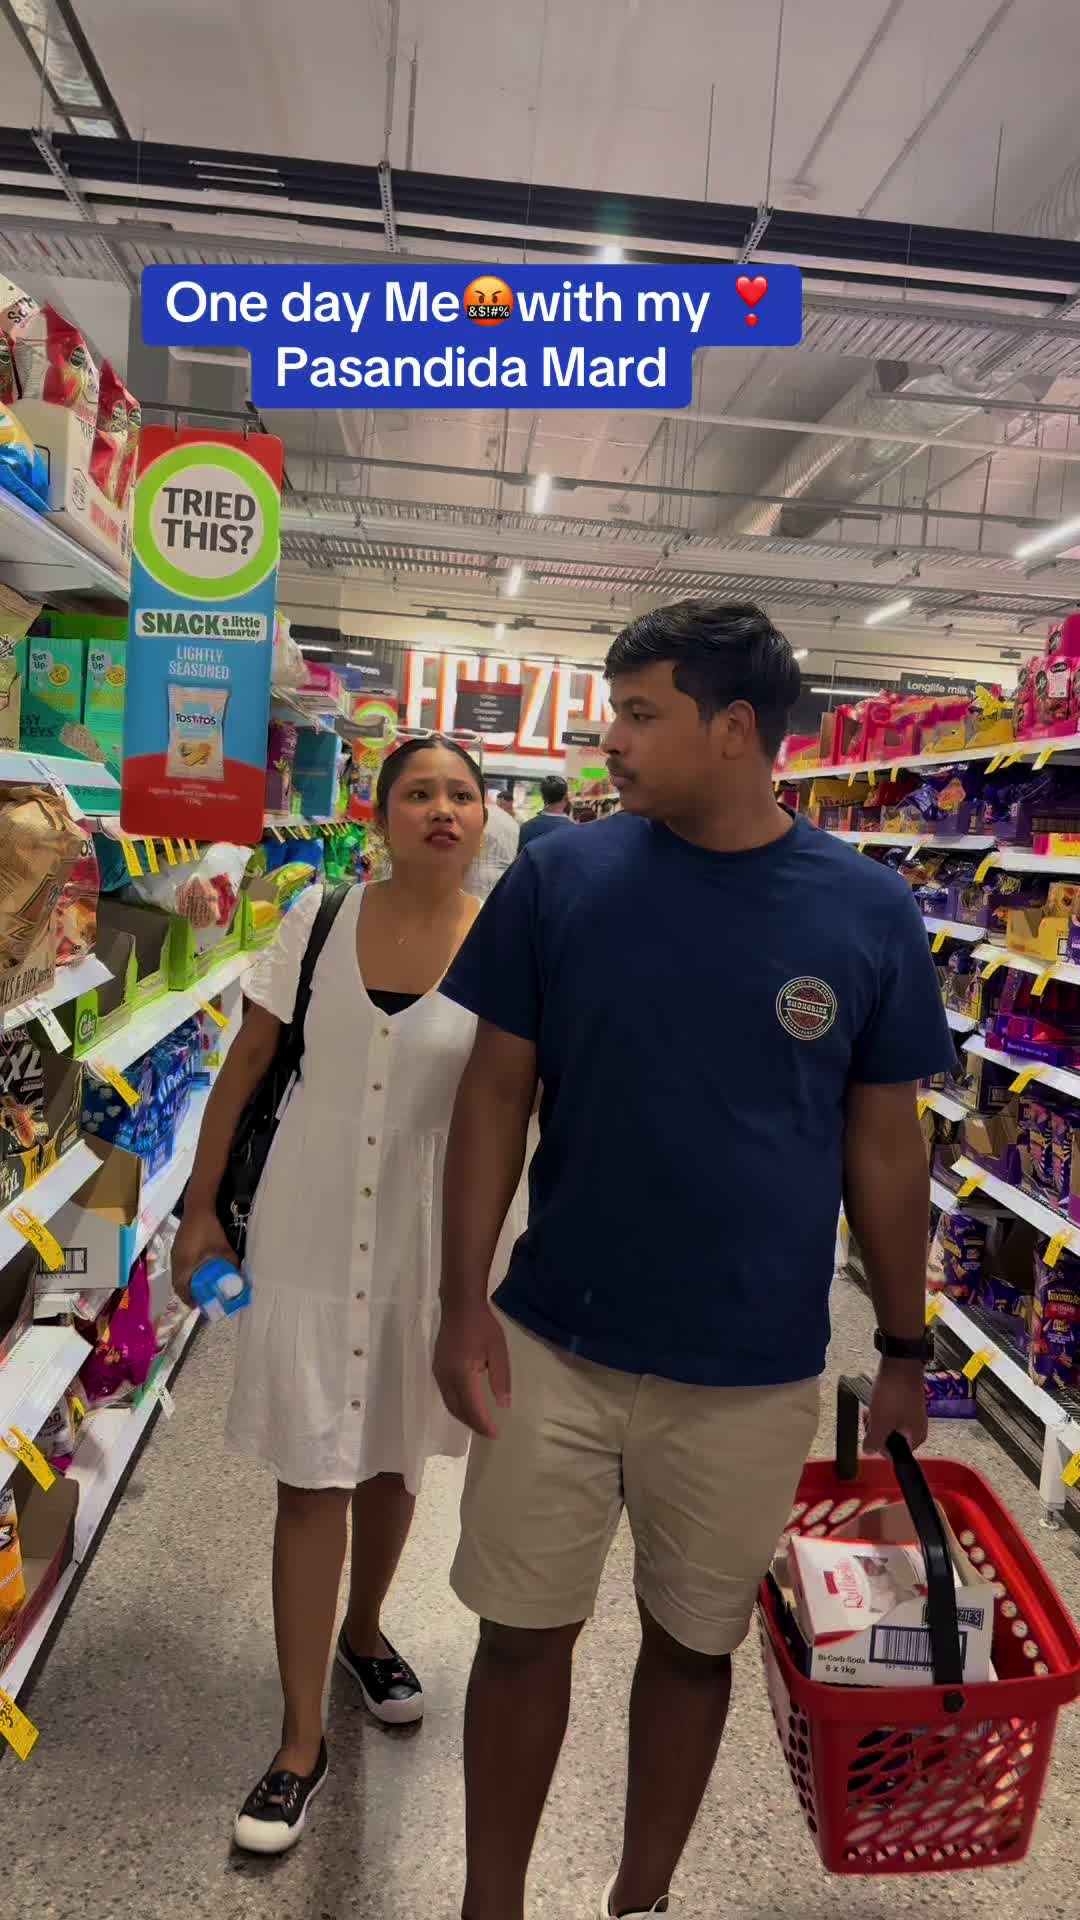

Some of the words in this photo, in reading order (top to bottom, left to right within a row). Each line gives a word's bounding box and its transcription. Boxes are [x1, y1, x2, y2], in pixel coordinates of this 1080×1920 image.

[162, 487, 256, 522] TRIED
[161, 518, 254, 555] THIS?
[142, 612, 220, 636] SNACK
[222, 618, 230, 627] a
[232, 615, 260, 628] little
[222, 628, 260, 638] smarter
[176, 645, 225, 663] LIGHTLY
[169, 661, 230, 680] SEASONED
[907, 680, 945, 695] Longlife
[947, 685, 968, 696] milk
[847, 1655, 866, 1664] Soda
[841, 1665, 856, 1675] 1kg
